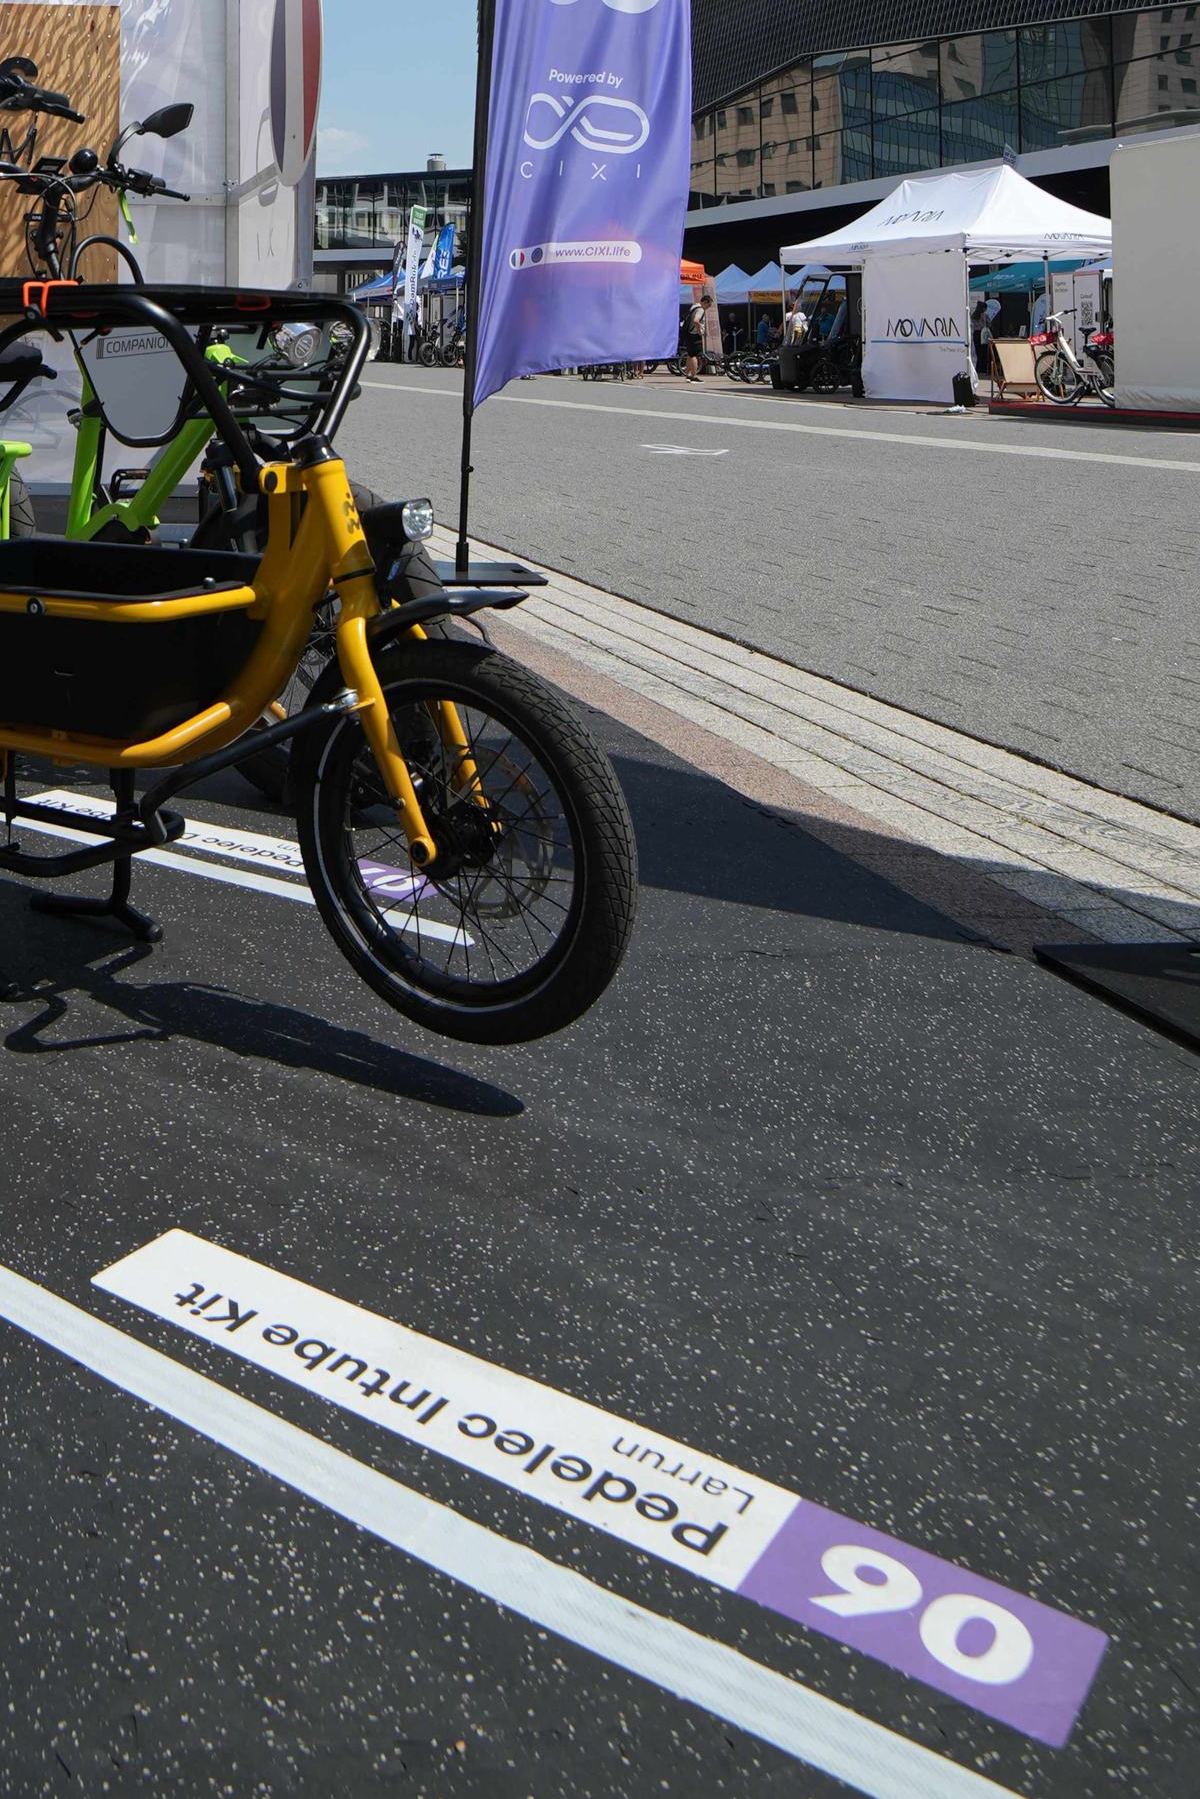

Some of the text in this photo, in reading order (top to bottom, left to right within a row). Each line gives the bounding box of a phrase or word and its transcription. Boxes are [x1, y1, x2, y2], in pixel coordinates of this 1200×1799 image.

[548, 69, 624, 89] Powered by
[520, 160, 641, 181] CIXI
[555, 246, 631, 258] www.CIXI.life
[172, 1280, 729, 1558] Pedelec Intube Kit
[610, 1435, 758, 1516] Larrun
[806, 1542, 1035, 1685] 06
